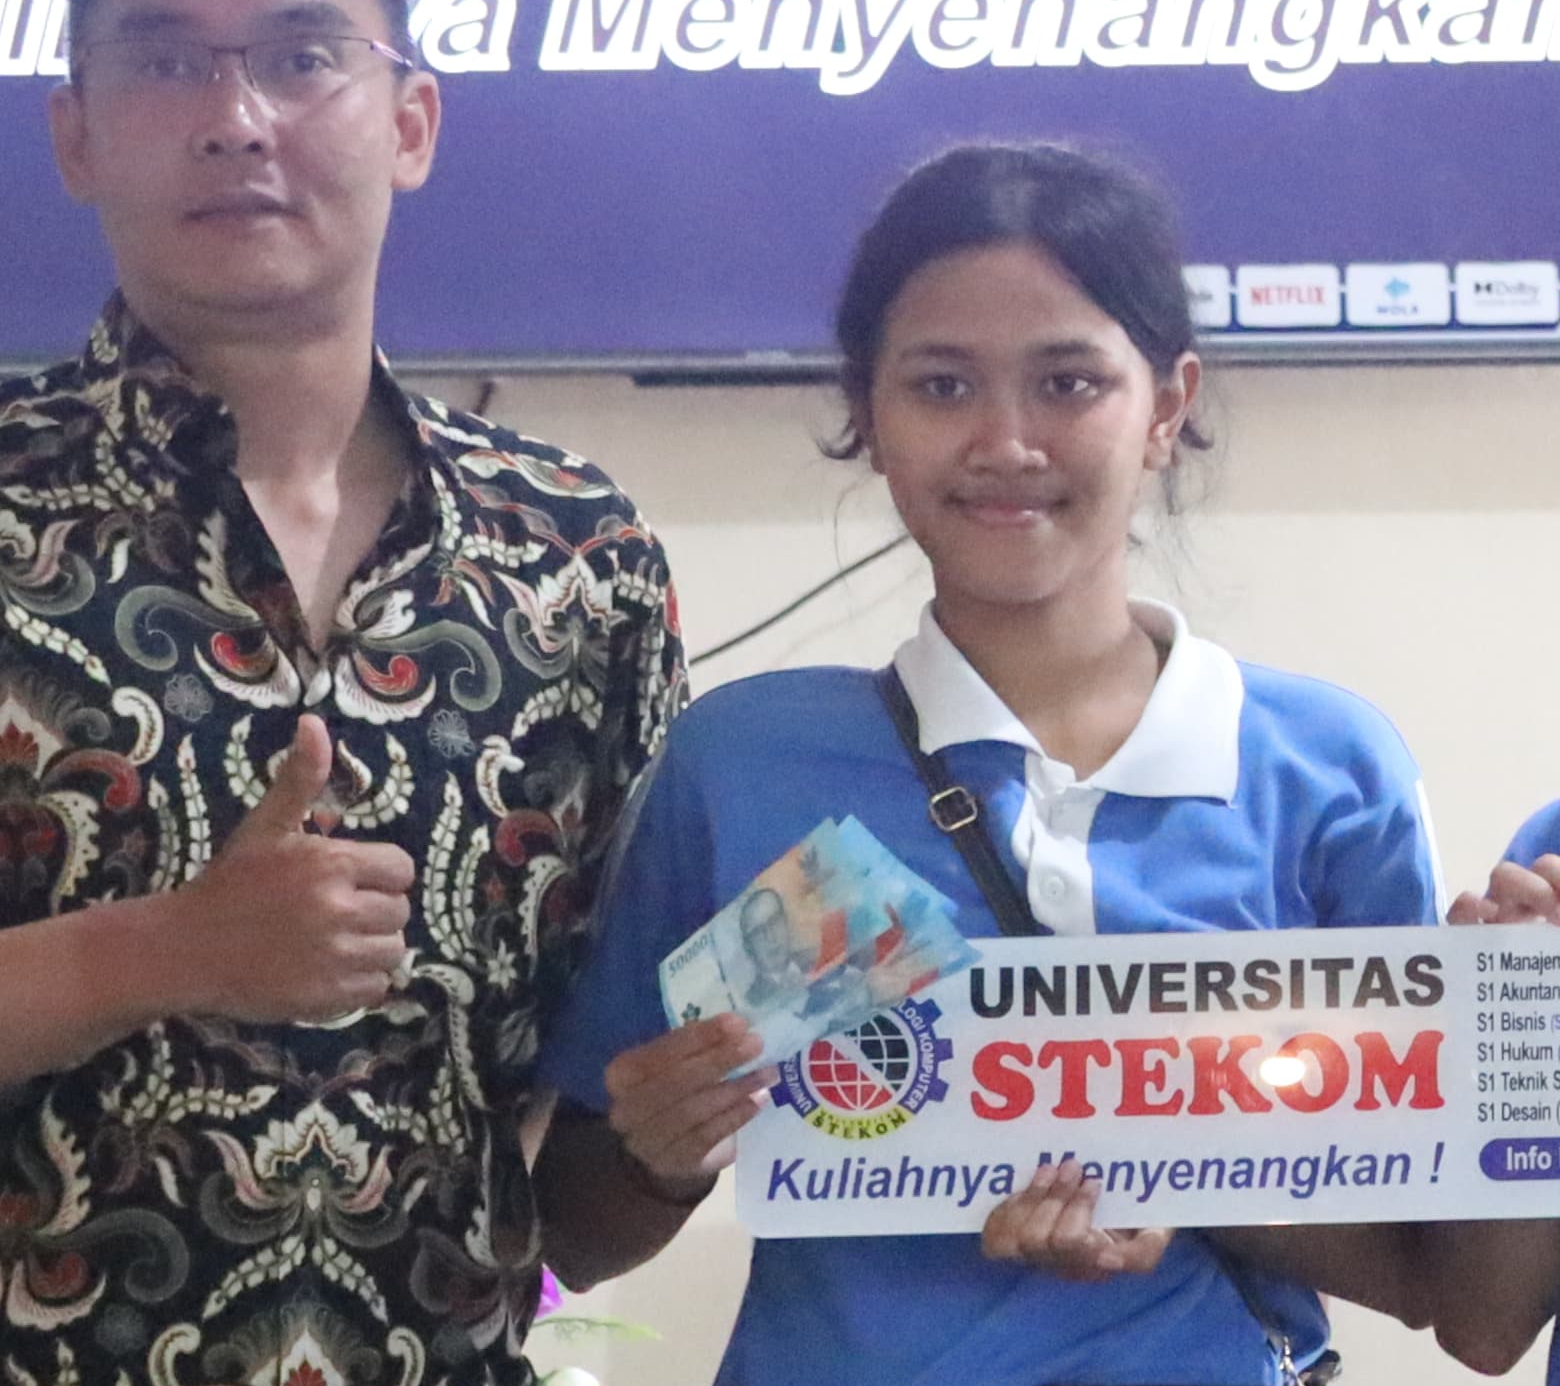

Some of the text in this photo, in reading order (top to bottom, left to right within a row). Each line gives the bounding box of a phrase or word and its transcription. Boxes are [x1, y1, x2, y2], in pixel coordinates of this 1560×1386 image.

[1250, 285, 1326, 306] NETFLIX
[1477, 953, 1494, 971] S1
[970, 954, 1445, 1019] UNIVERSITAS
[1477, 982, 1494, 1001] S1
[1477, 1013, 1494, 1032] S1
[1501, 1012, 1546, 1031] Bisnis
[1477, 1044, 1494, 1062] S1
[1501, 1042, 1553, 1061] Hukum
[905, 1031, 935, 1113] KOMPUTER
[970, 1030, 1445, 1121] STEKOM
[1478, 1073, 1495, 1092] S1
[1501, 1072, 1548, 1091] Teknik
[1478, 1103, 1495, 1122] S1
[1502, 1102, 1551, 1122] Desain
[1506, 1146, 1552, 1171] Info
[767, 1156, 1015, 1207] Kuliahnya
[1428, 1142, 1445, 1184] !
